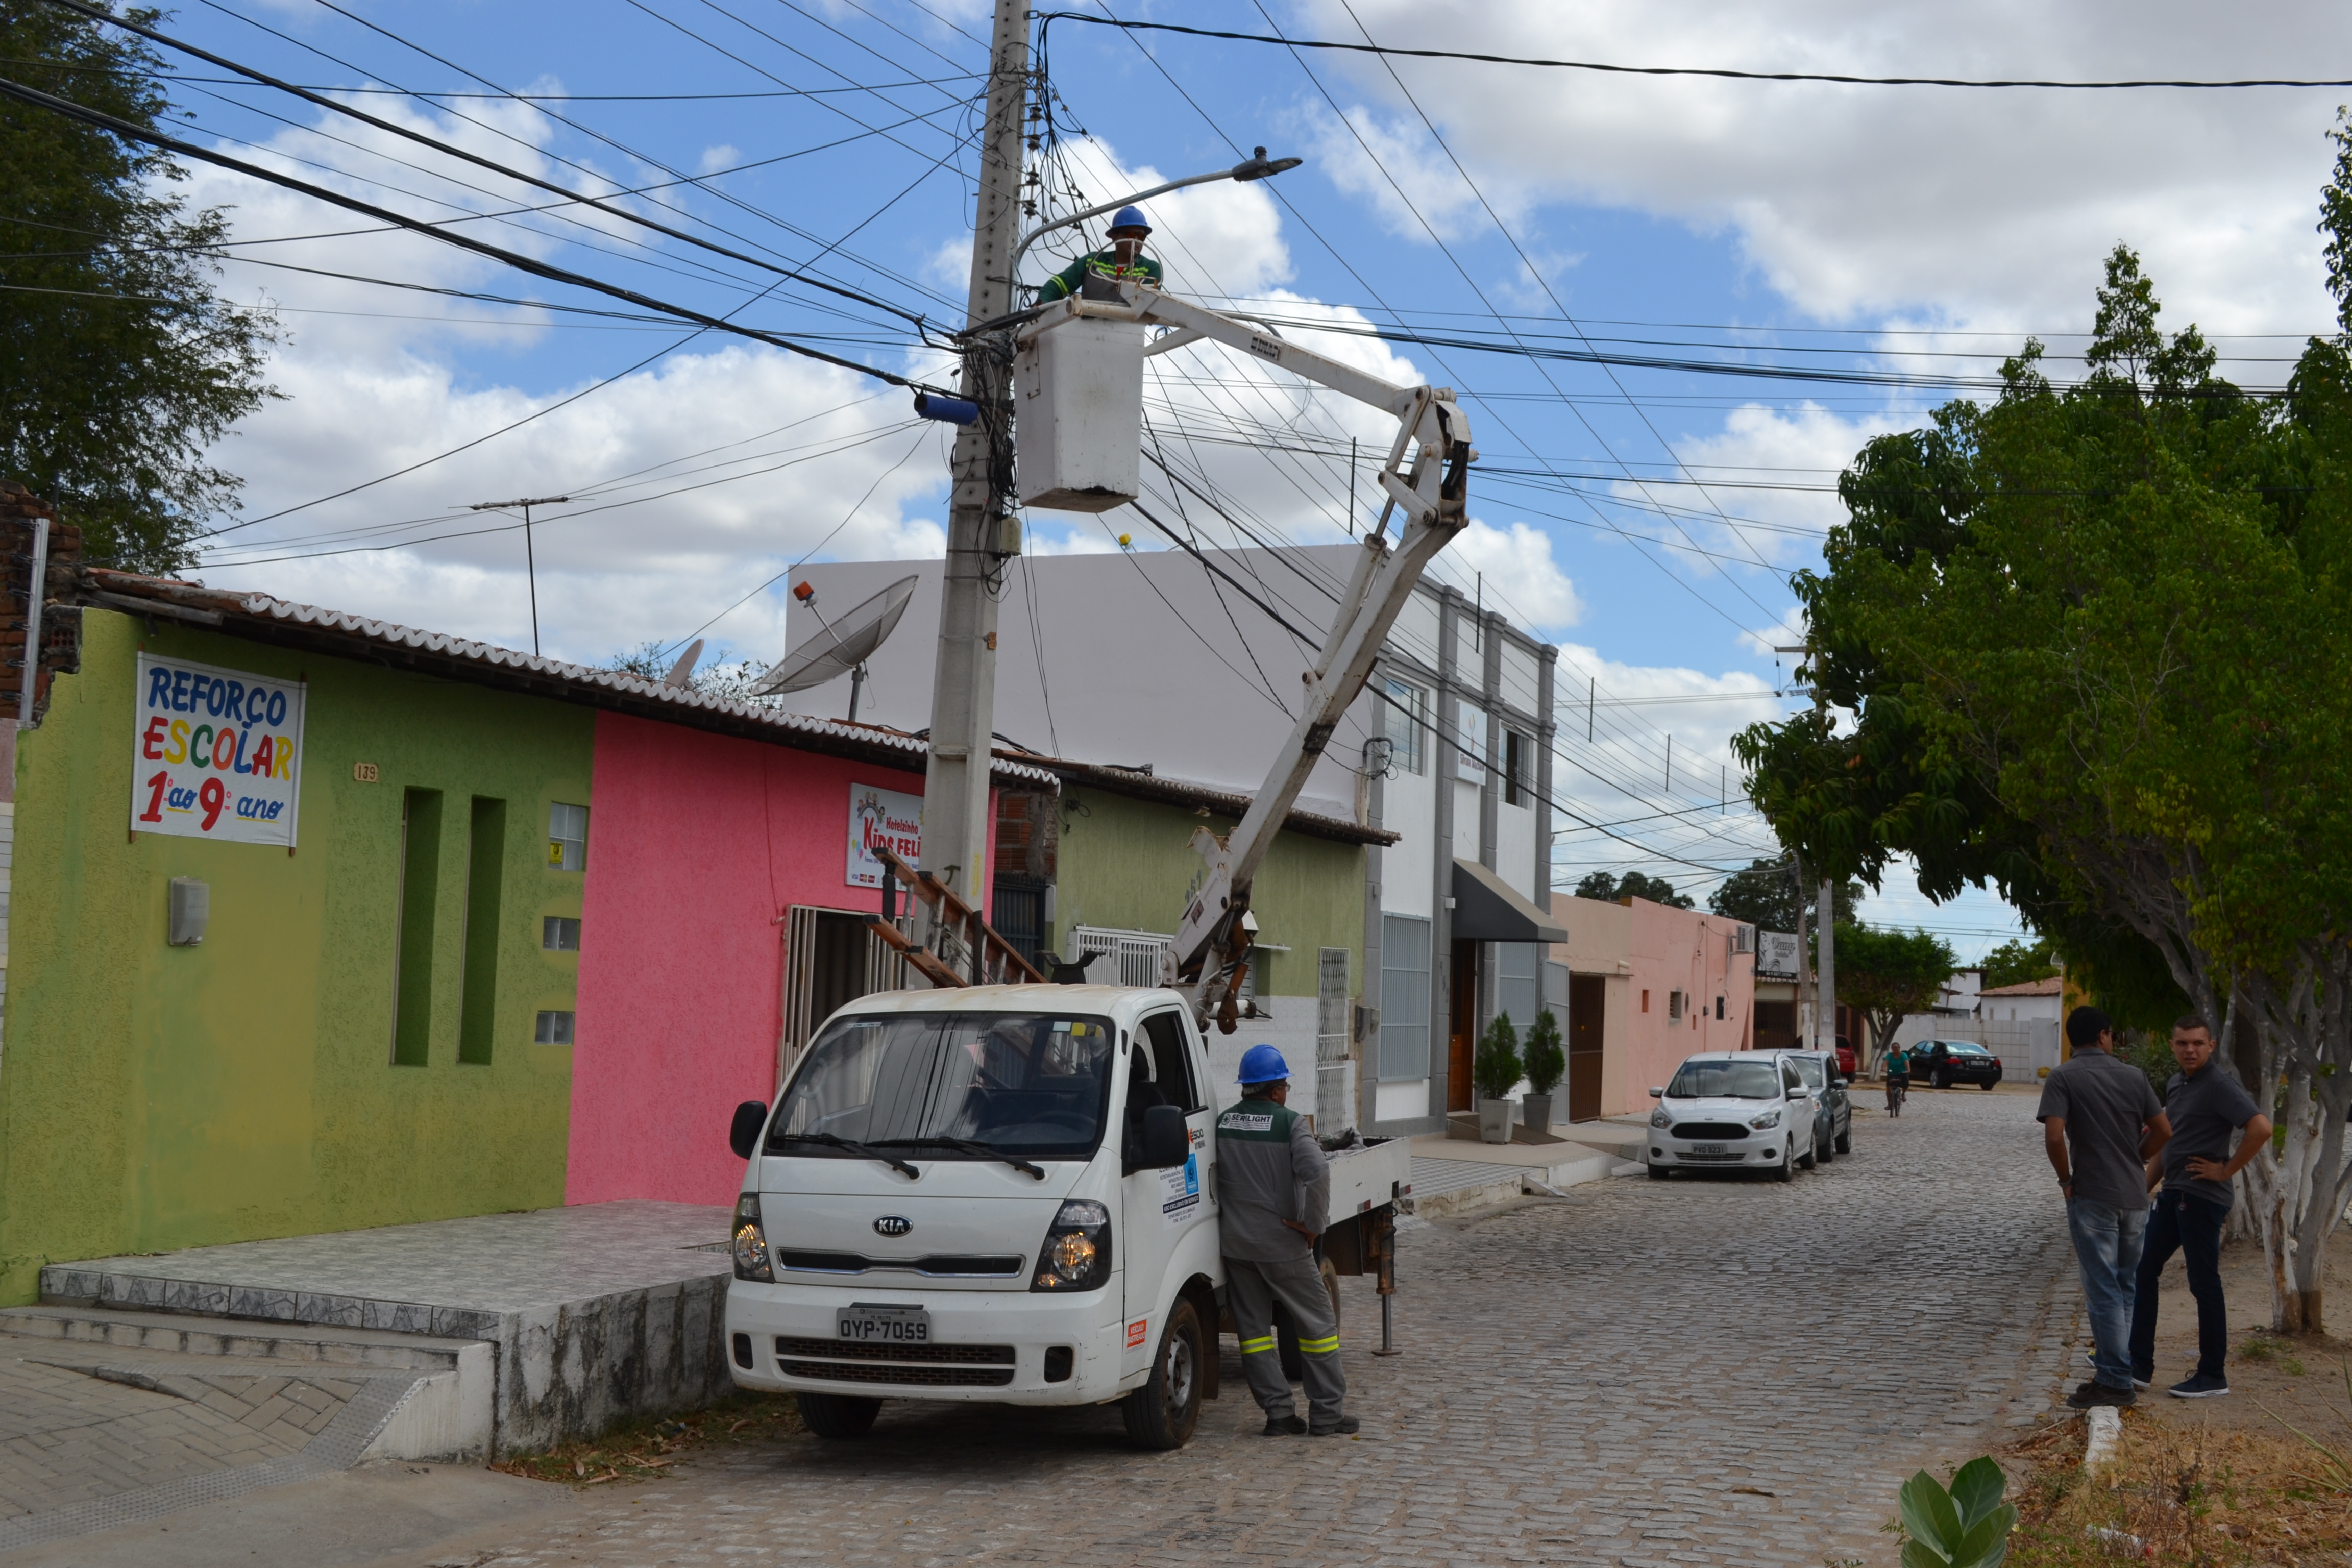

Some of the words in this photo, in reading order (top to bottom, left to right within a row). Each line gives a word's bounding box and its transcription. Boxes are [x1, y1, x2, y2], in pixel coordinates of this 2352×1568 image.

[148, 667, 287, 730] REFORÇO
[143, 716, 294, 781] ESCOLAR
[358, 765, 375, 780] 139
[168, 787, 198, 810] ao
[236, 794, 284, 820] ano
[886, 816, 918, 835] Hotelzinho
[1771, 937, 1796, 954] Vany
[1170, 1200, 1184, 1210] EXCLUSIVO
[879, 1220, 905, 1232] KIA
[1130, 1324, 1144, 1334] VEÍCULO
